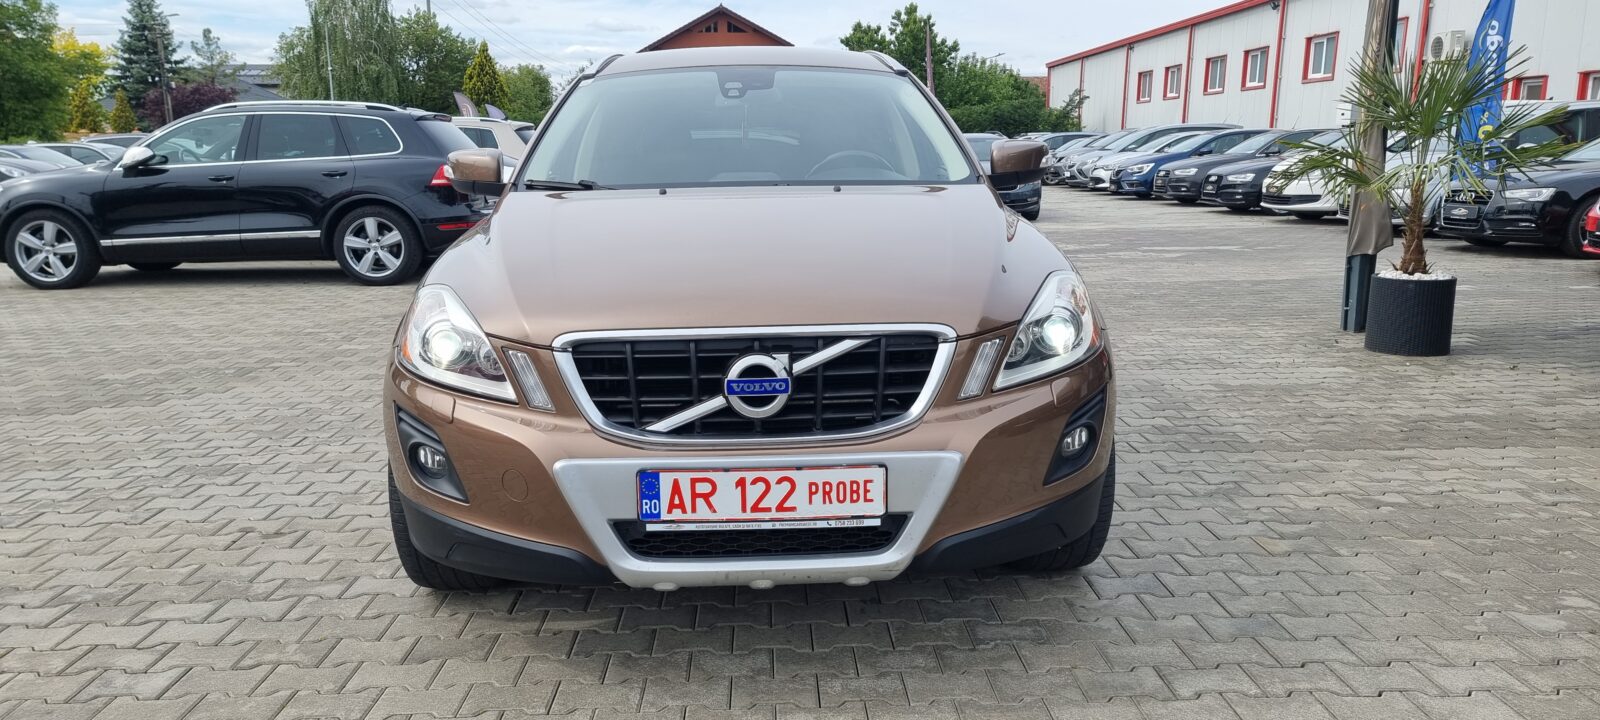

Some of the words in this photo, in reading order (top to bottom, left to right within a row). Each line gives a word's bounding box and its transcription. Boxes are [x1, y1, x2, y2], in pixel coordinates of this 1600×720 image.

[730, 381, 786, 392] VOLVO
[666, 476, 718, 514] AR
[735, 475, 797, 513] 122
[808, 479, 874, 505] PROBE
[642, 499, 660, 514] RO
